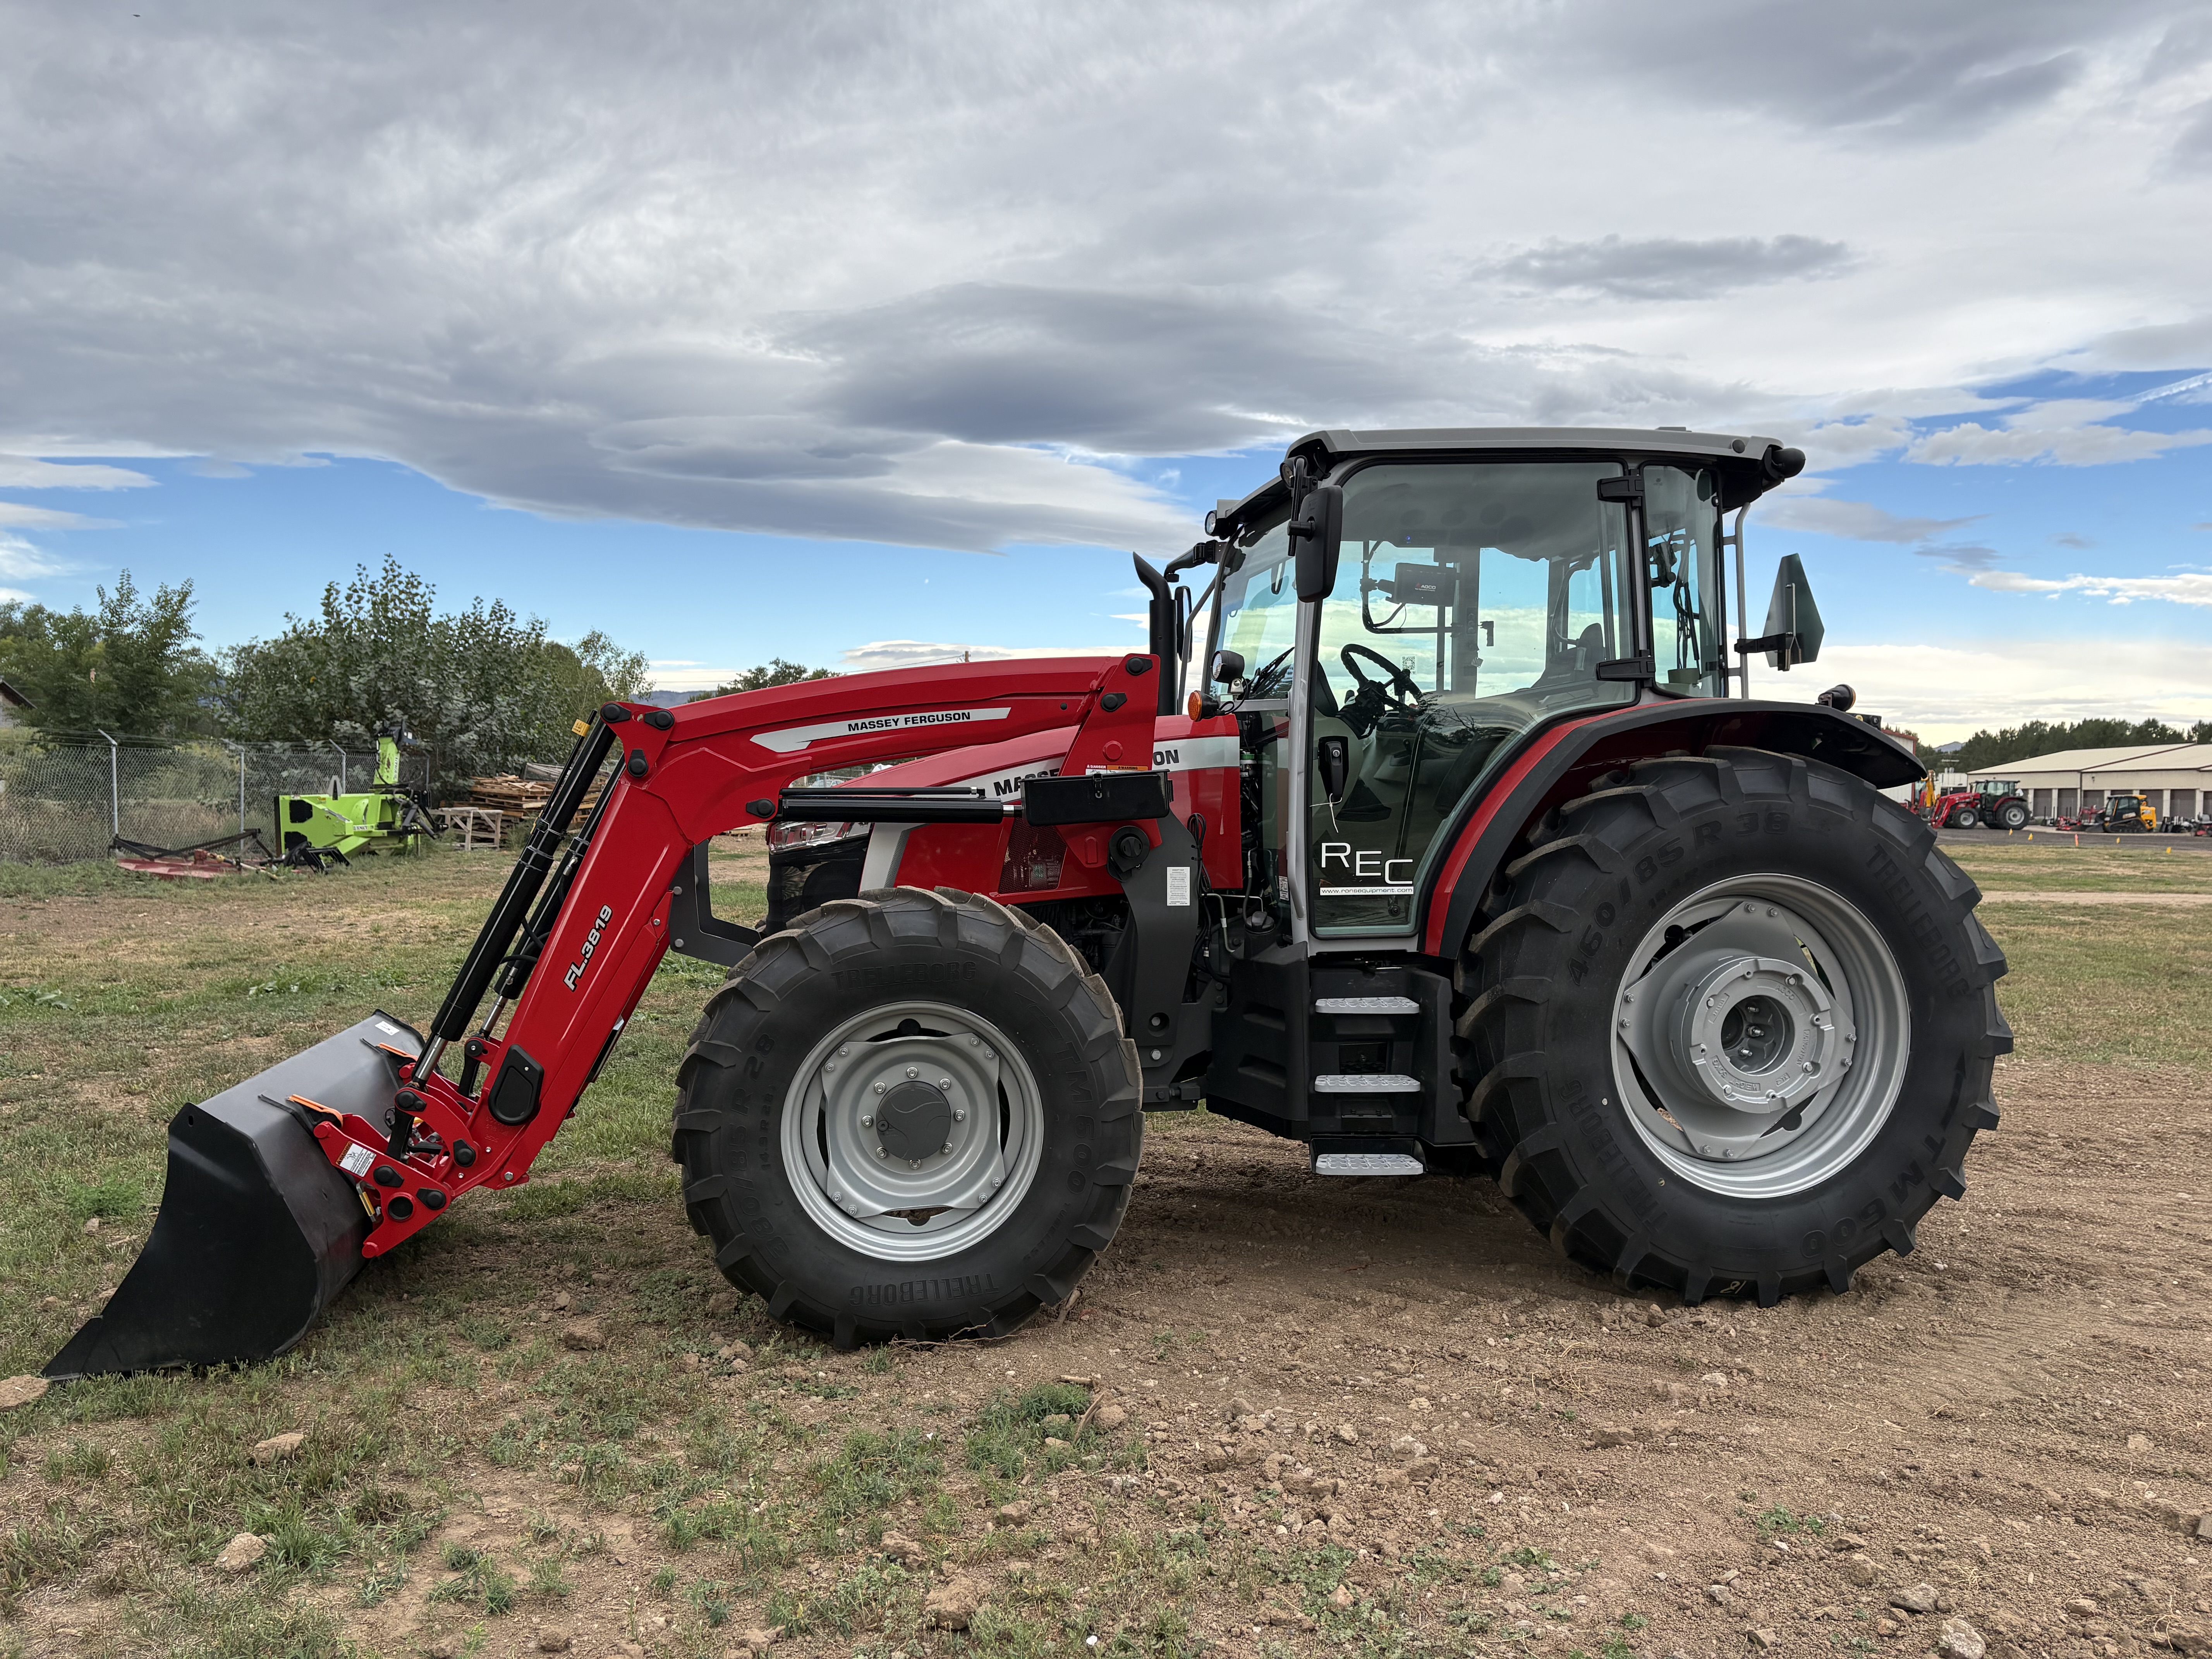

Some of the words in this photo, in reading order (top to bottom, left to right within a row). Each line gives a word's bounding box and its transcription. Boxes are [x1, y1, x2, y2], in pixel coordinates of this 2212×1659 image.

[848, 718, 899, 732] MASSEY
[905, 712, 970, 725] FERGUSON
[1321, 843, 1413, 884] REC
[1568, 837, 1684, 986] 460/85
[1693, 821, 1723, 850] R
[1736, 812, 1790, 836] 38
[1867, 843, 1969, 998] TRELLEBORG
[563, 905, 612, 991] FL.3819
[829, 960, 976, 992] TRELLEBORG
[744, 1034, 775, 1082] 28
[1055, 1041, 1093, 1103] TM
[731, 1088, 752, 1115] R
[1066, 1115, 1095, 1194] 600
[1559, 1079, 1669, 1235] TRELLEBORG
[1889, 1134, 1946, 1206] TM
[729, 1125, 789, 1259] 380/85
[1801, 1197, 1887, 1258] 600
[849, 1273, 1000, 1306] TRELLEBORG
